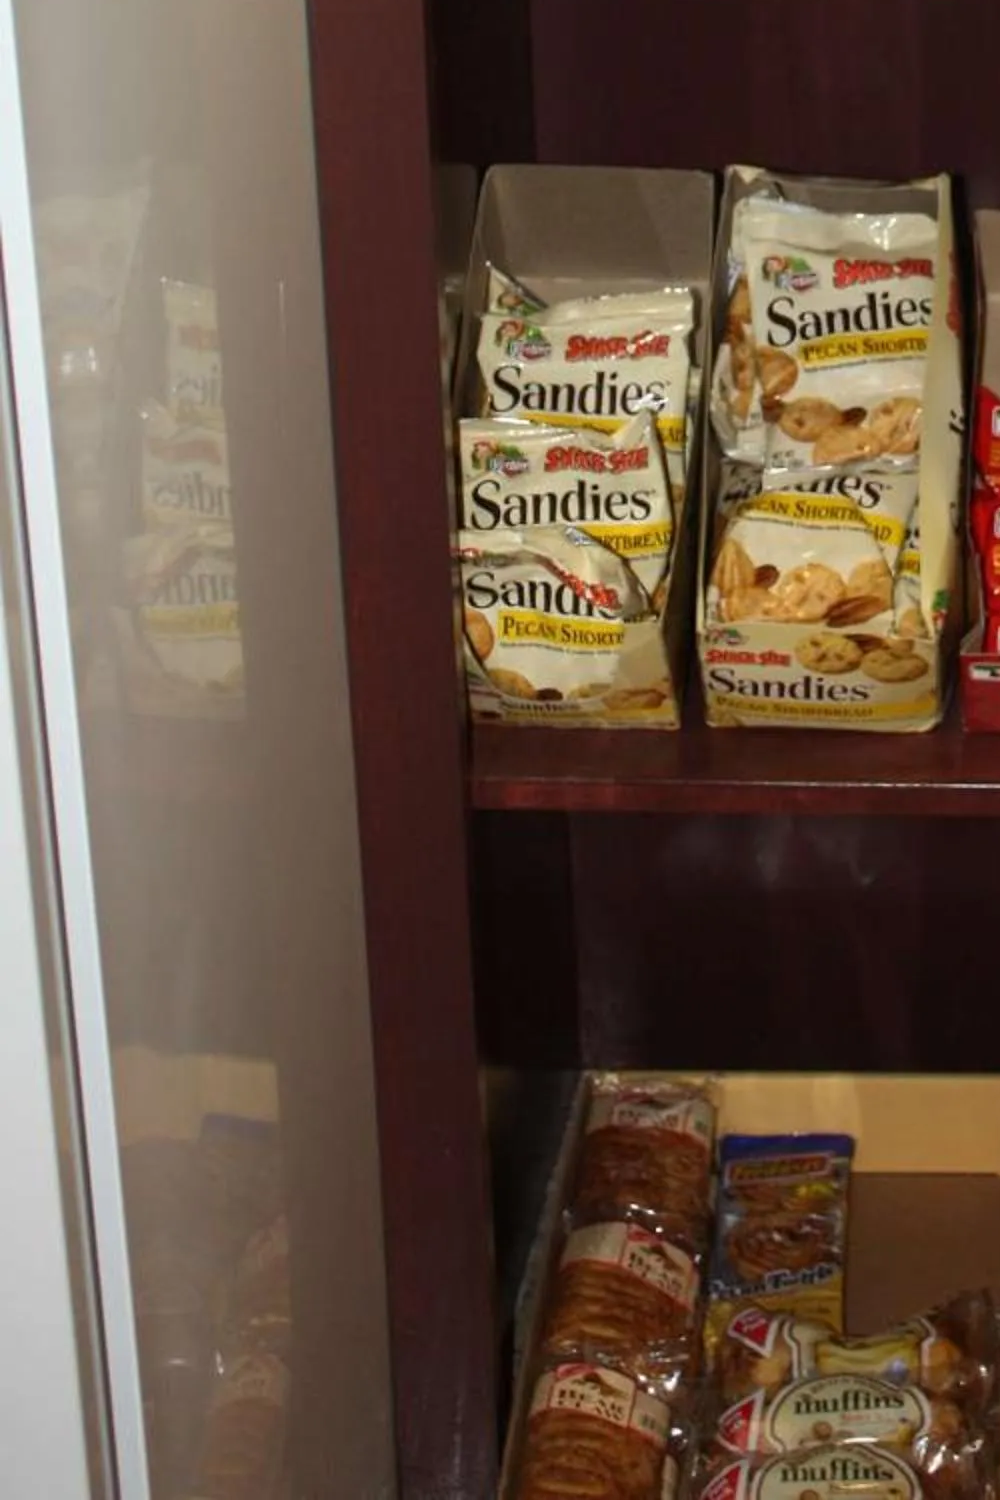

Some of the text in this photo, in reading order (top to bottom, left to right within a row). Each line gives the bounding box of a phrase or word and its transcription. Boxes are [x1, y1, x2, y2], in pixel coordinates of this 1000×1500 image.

[766, 291, 933, 349] Sandies
[803, 336, 928, 362] PECAN SHORTB
[490, 364, 667, 417] Sandies
[470, 478, 653, 531] Sandies
[465, 570, 618, 621] Sand
[502, 615, 558, 641] PECAN
[708, 667, 871, 702] Sandies
[793, 1389, 905, 1416] muffins
[780, 1458, 894, 1483] muffins
